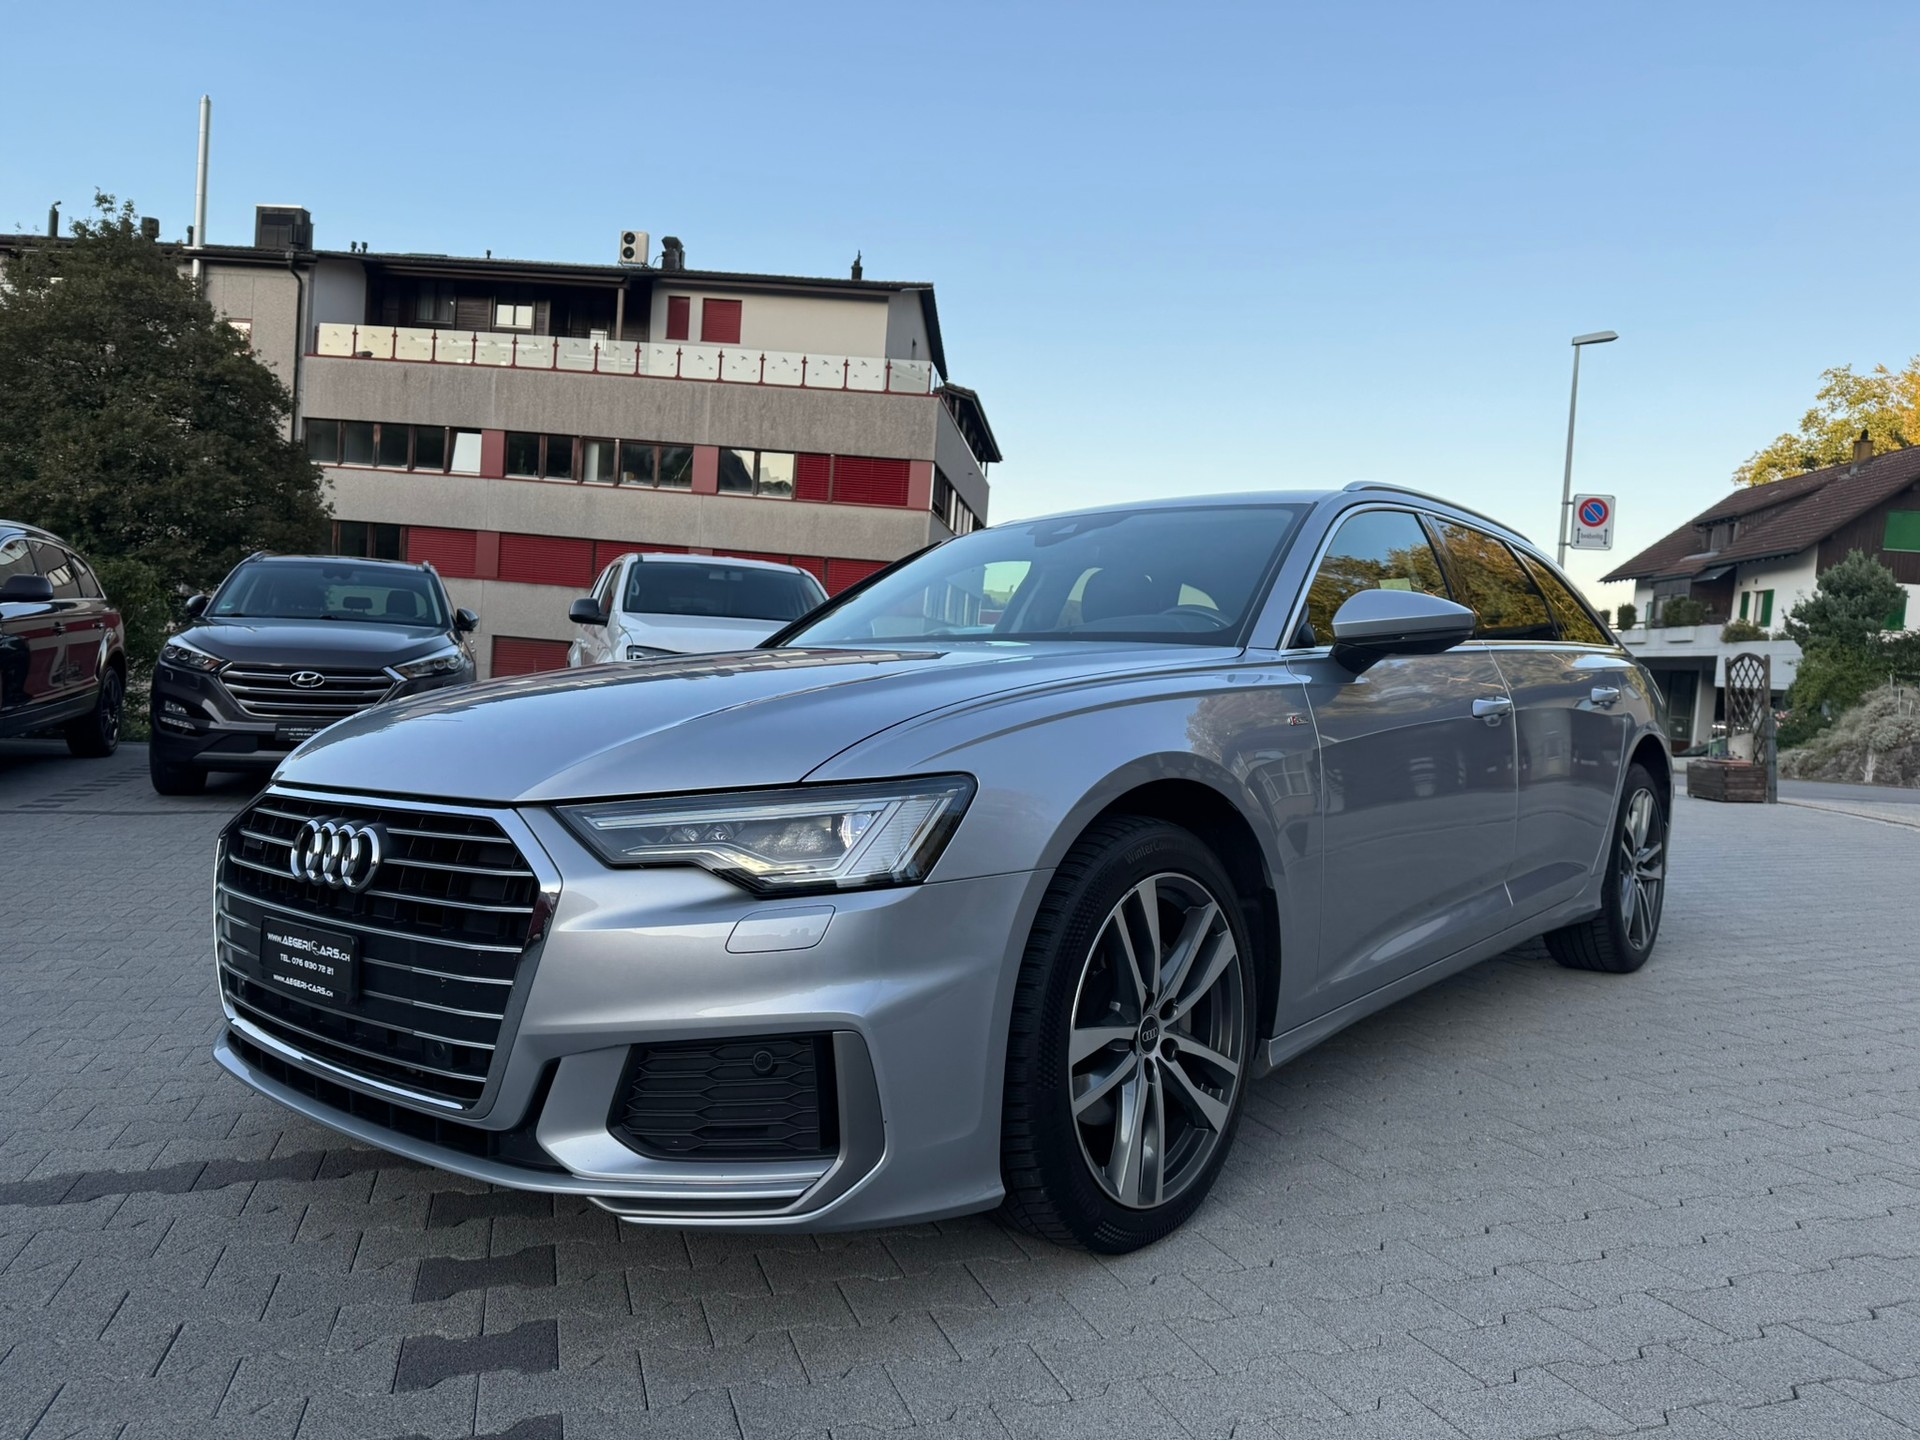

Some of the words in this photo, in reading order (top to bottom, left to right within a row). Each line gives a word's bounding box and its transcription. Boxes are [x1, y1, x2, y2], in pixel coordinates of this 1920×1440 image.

[292, 957, 303, 967] 076
[304, 960, 317, 970] 830
[318, 964, 326, 973] 72
[327, 967, 334, 976] 21
